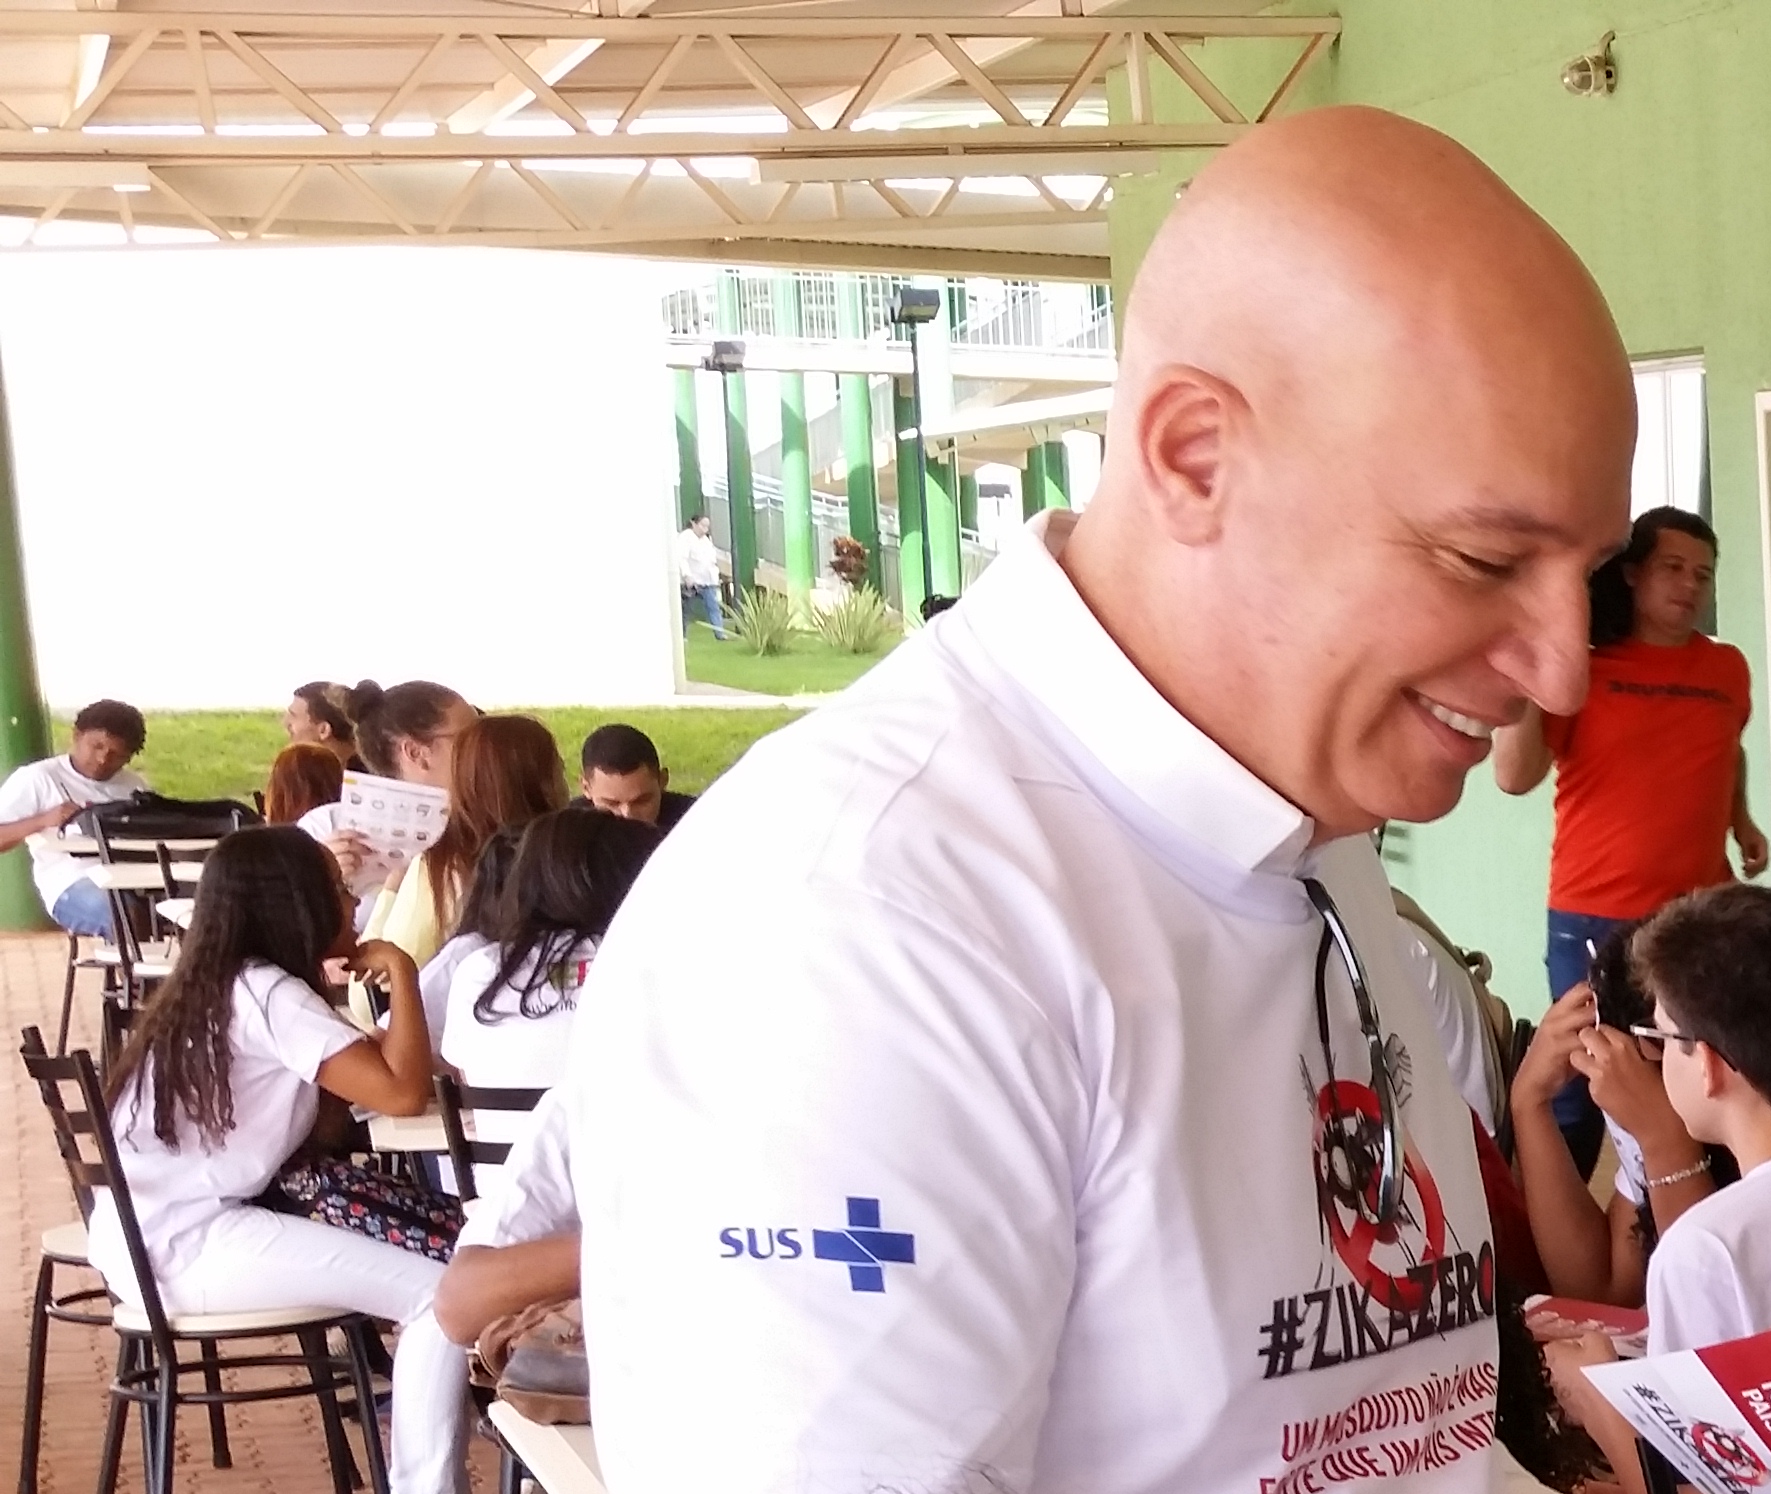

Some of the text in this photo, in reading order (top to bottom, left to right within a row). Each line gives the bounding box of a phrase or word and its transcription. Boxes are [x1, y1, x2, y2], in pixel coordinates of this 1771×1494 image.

[719, 1227, 803, 1260] SUS
[1321, 1446, 1388, 1482] QUE
[1448, 1409, 1496, 1452] INT
